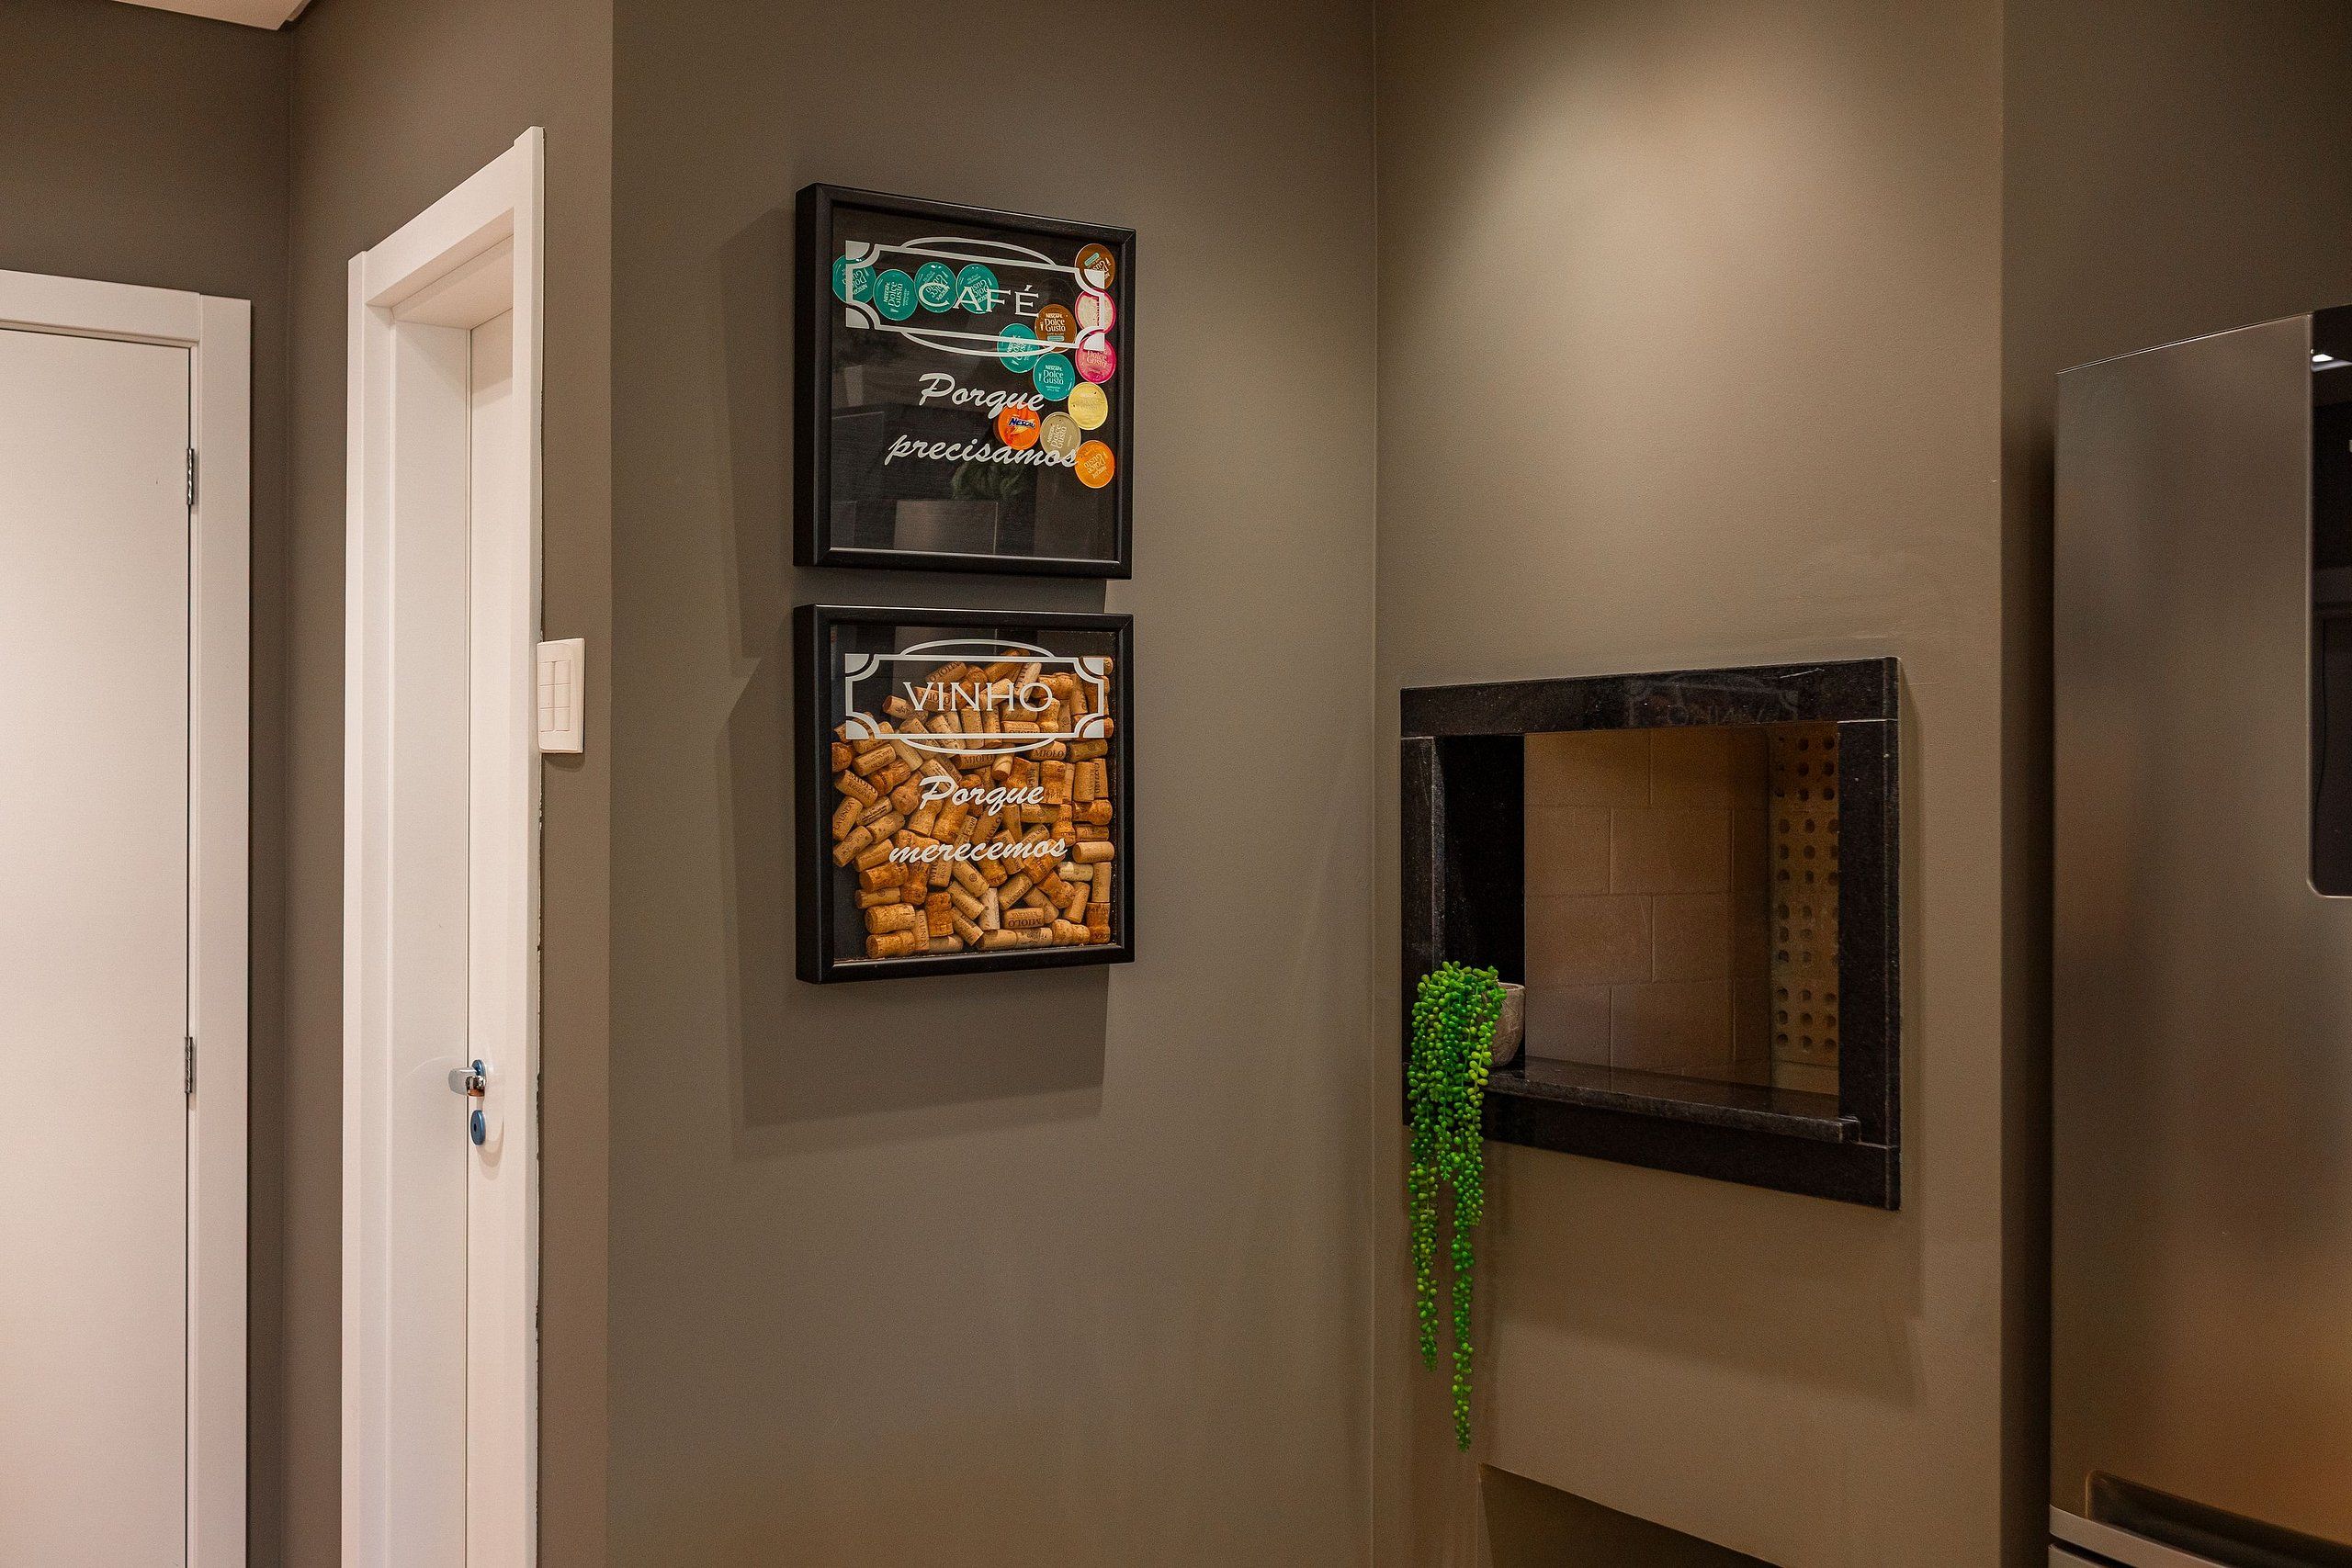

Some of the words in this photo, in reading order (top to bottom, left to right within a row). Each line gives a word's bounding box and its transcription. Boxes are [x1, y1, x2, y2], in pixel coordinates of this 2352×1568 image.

[887, 281, 897, 306] Dolce
[893, 282, 903, 307] Gusto
[918, 282, 1039, 317] CAFÉ
[1044, 318, 1065, 326] Dolce
[1045, 324, 1065, 333] Gusto
[1085, 355, 1107, 367] Gusto
[1043, 369, 1063, 378] Dolce
[1043, 376, 1063, 384] Gusto
[918, 372, 1045, 420] Porque
[1049, 423, 1063, 447] Dolce
[1055, 425, 1069, 448] Gusto
[884, 434, 1079, 468] precisamos
[1082, 452, 1102, 468] Gusto
[1085, 457, 1106, 474] Dolce
[902, 682, 1053, 712] VINHO
[1035, 750, 1064, 758] MIOLO
[918, 775, 1045, 817] Porque
[888, 837, 1069, 863] merecemos
[1008, 919, 1042, 927] MIOLO
